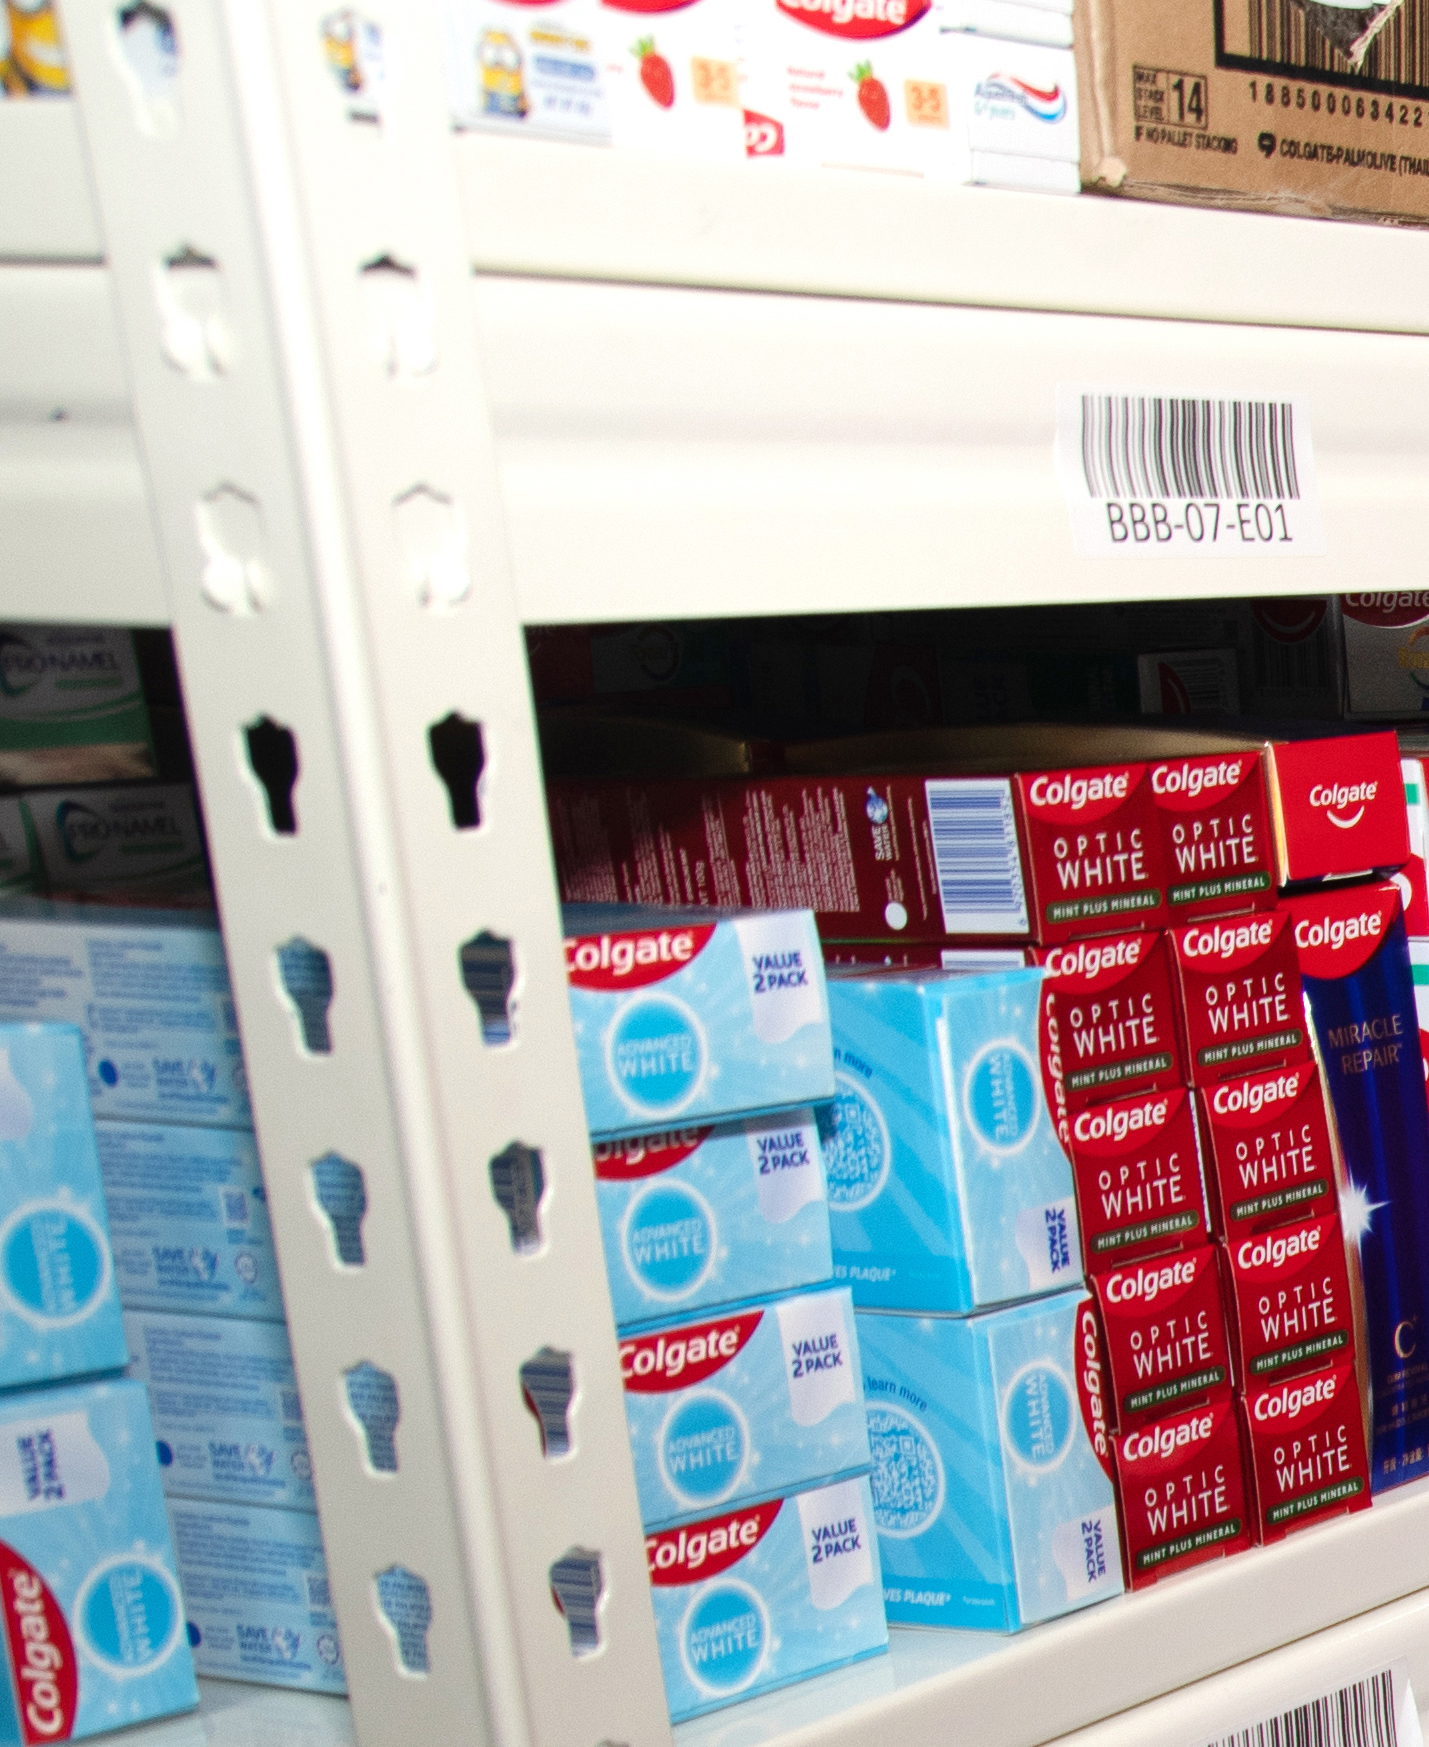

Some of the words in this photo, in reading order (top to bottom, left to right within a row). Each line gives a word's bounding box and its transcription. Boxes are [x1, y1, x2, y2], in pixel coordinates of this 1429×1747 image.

[1172, 77, 1204, 123] 14
[1107, 502, 1294, 542] BBB-07-E01
[1029, 772, 1130, 810] Colgate
[1151, 759, 1244, 797] Colgate
[1309, 782, 1378, 808] Colgate
[1054, 828, 1143, 859] OPTIC
[1172, 814, 1253, 844] OPTIC
[1056, 851, 1149, 890] WHITE
[1175, 835, 1259, 873] WHITE
[1172, 885, 1197, 901] MINT
[1199, 881, 1223, 897] PLUS
[1224, 877, 1265, 893] MINERAL
[1053, 903, 1079, 920] MINT
[1081, 899, 1107, 915] PLUS
[1108, 894, 1155, 912] MINERAL
[753, 952, 802, 974] VALUE
[1328, 1014, 1403, 1047] MIRACLE
[1342, 1044, 1399, 1075] REPAIR
[1237, 1226, 1322, 1270] Colgate
[1106, 1258, 1197, 1304] Colgate
[792, 1334, 839, 1357] VALUE
[1130, 1311, 1208, 1350] OPTIC
[1133, 1333, 1214, 1379] WHITE
[1181, 1371, 1220, 1394] MINERAL
